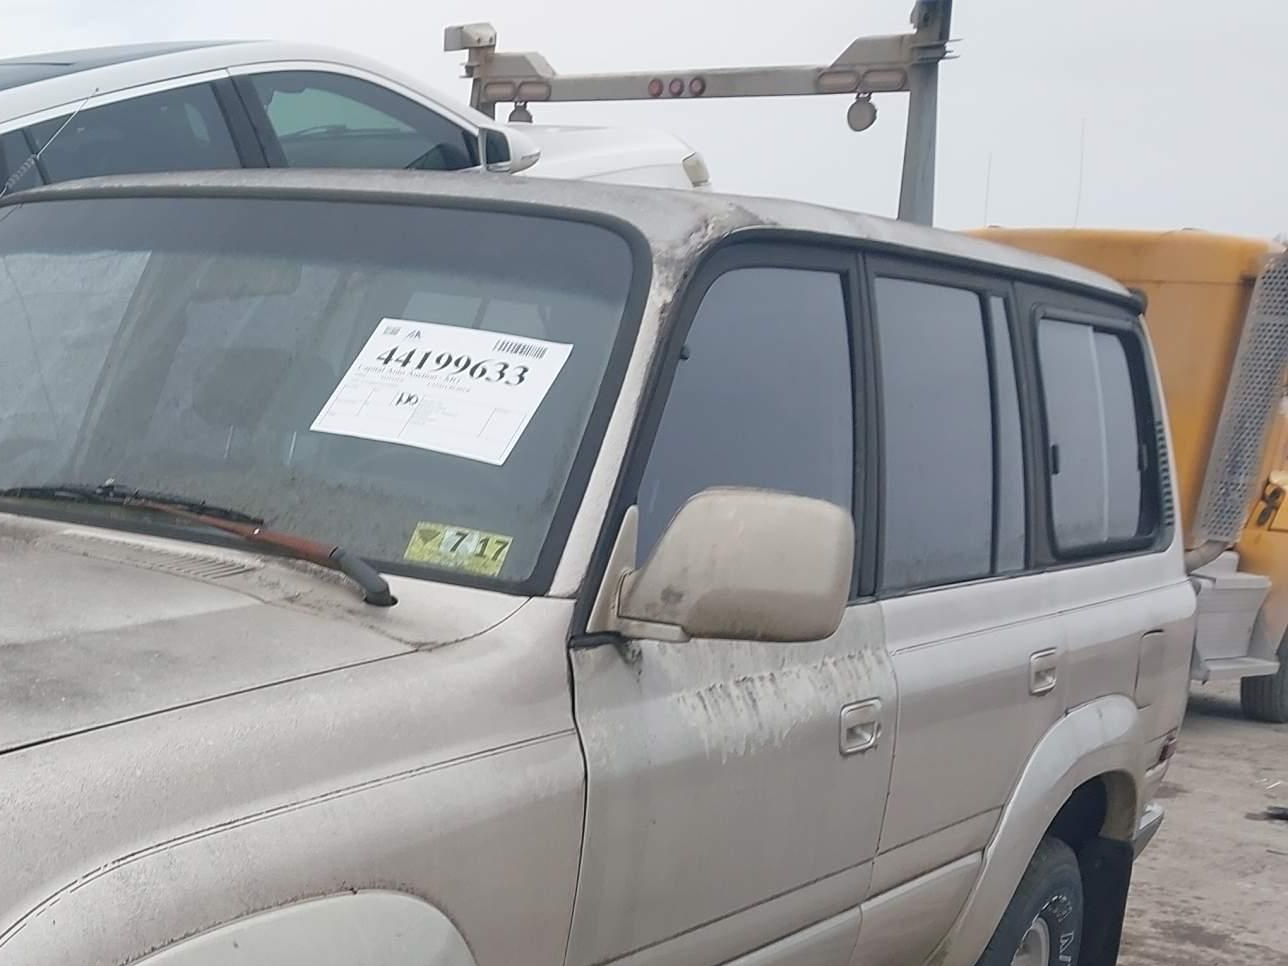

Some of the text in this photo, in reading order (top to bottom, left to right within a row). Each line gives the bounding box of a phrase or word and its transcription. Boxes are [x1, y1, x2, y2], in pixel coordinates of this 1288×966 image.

[376, 345, 530, 387] 44199633
[449, 532, 509, 561] 7 17
